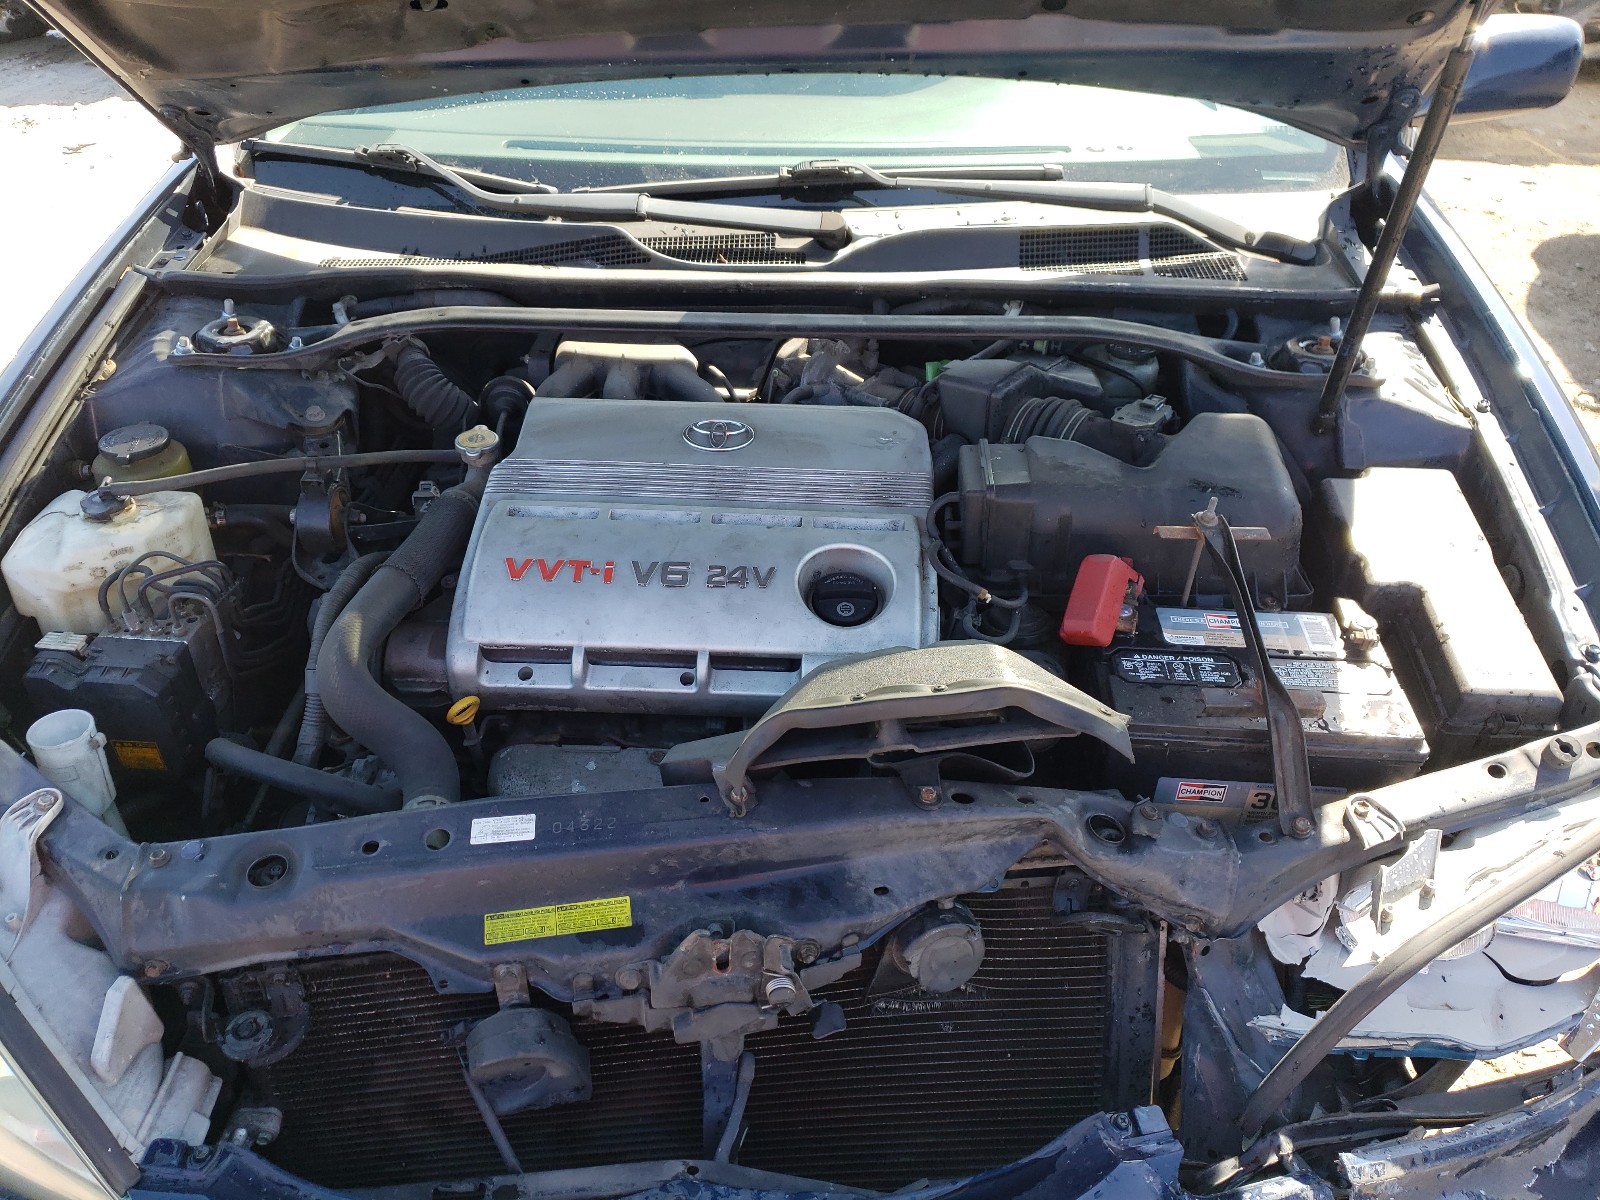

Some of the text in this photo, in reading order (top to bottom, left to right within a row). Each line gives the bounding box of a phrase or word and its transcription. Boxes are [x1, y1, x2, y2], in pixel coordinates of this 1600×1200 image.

[504, 557, 777, 589] VVT-i V6 24V
[1180, 788, 1223, 797] CHAMPION
